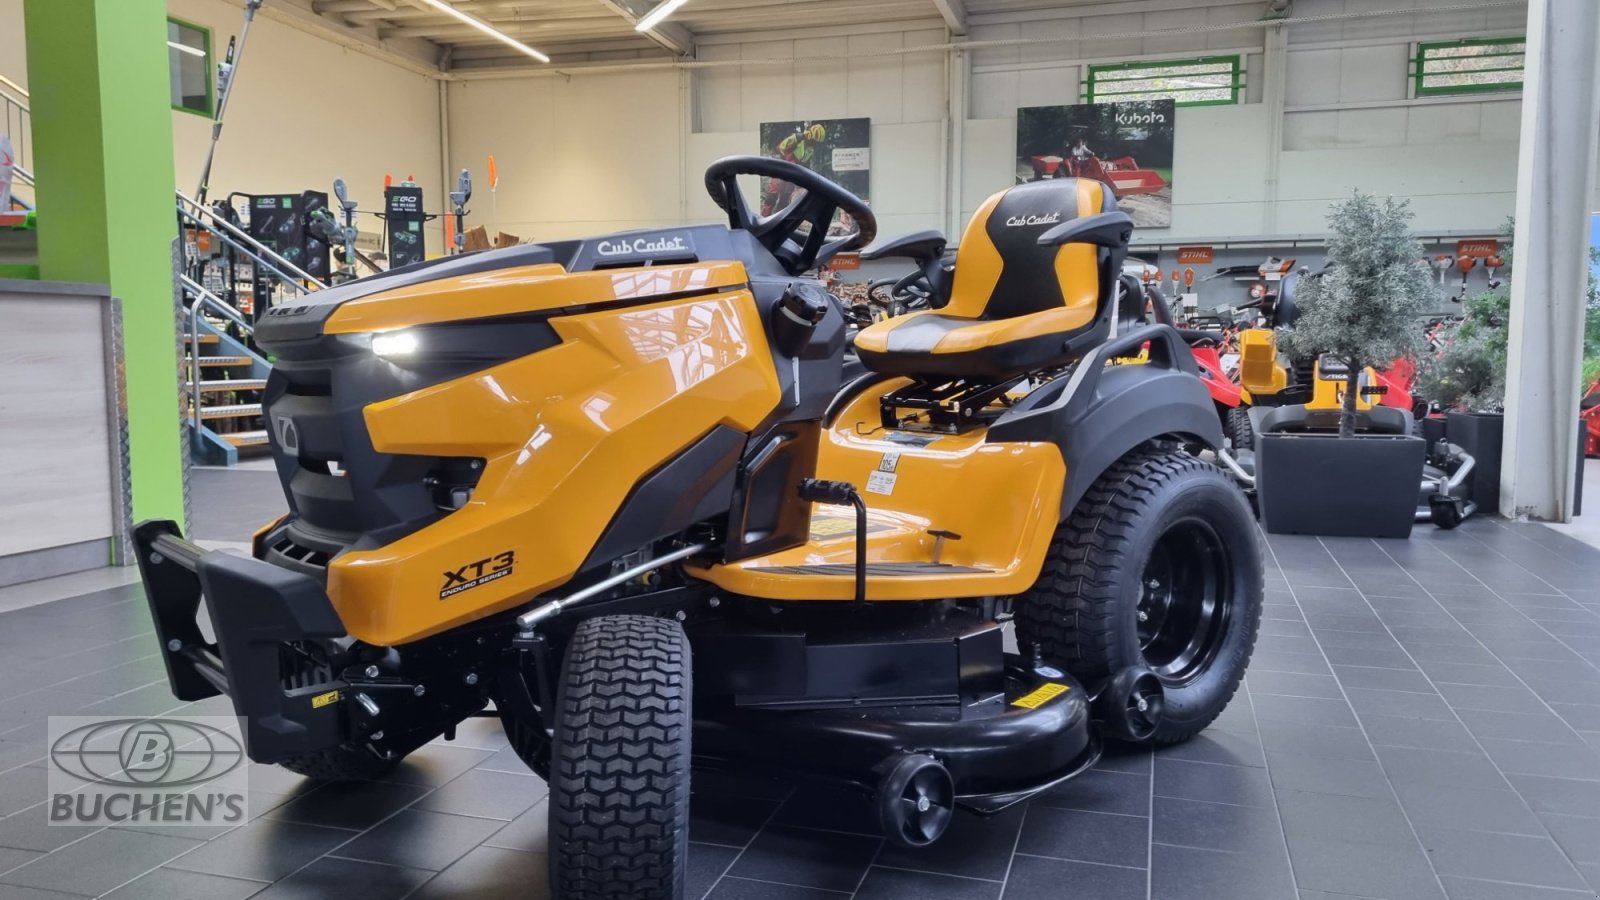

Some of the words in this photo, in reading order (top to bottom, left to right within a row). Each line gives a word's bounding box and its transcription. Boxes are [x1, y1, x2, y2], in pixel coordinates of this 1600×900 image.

[1115, 111, 1165, 124] Kubota
[392, 195, 417, 203] EGO
[1006, 216, 1026, 227] Cub
[1027, 212, 1060, 225] Cadet
[597, 240, 633, 256] Cub
[633, 236, 686, 253] Cadet
[1180, 250, 1209, 258] STIHL
[441, 550, 514, 589] XT3
[441, 581, 477, 597] ENDURO
[478, 569, 509, 584] SERIES
